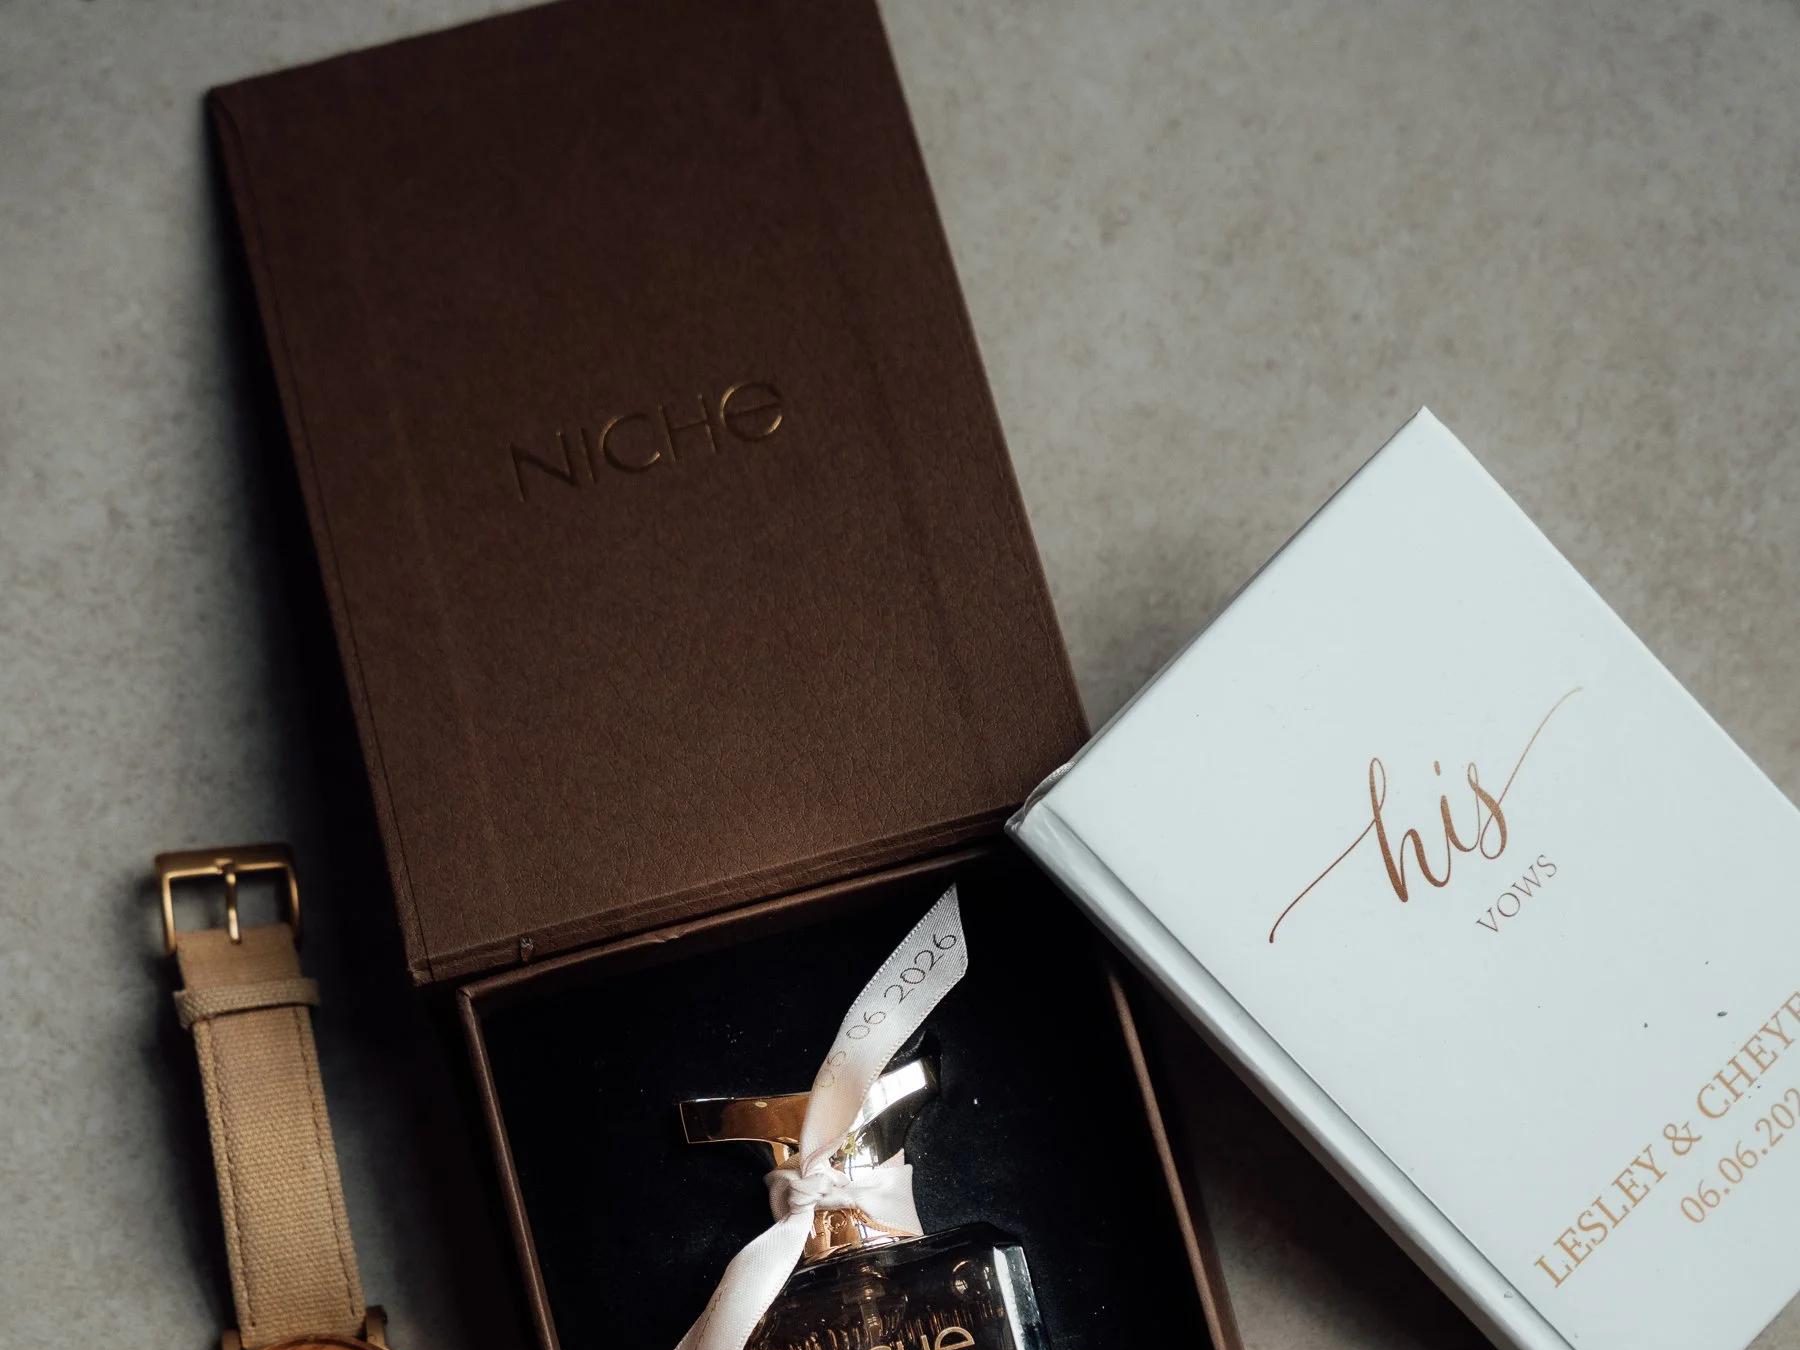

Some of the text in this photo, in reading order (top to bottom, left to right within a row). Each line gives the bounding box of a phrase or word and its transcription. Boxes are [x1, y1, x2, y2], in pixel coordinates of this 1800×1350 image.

[1269, 686, 1583, 944] his
[1476, 854, 1558, 933] VOWS
[884, 934, 957, 1003] 2026
[1534, 1144, 1667, 1288] LESLEY
[1663, 1122, 1703, 1157] &
